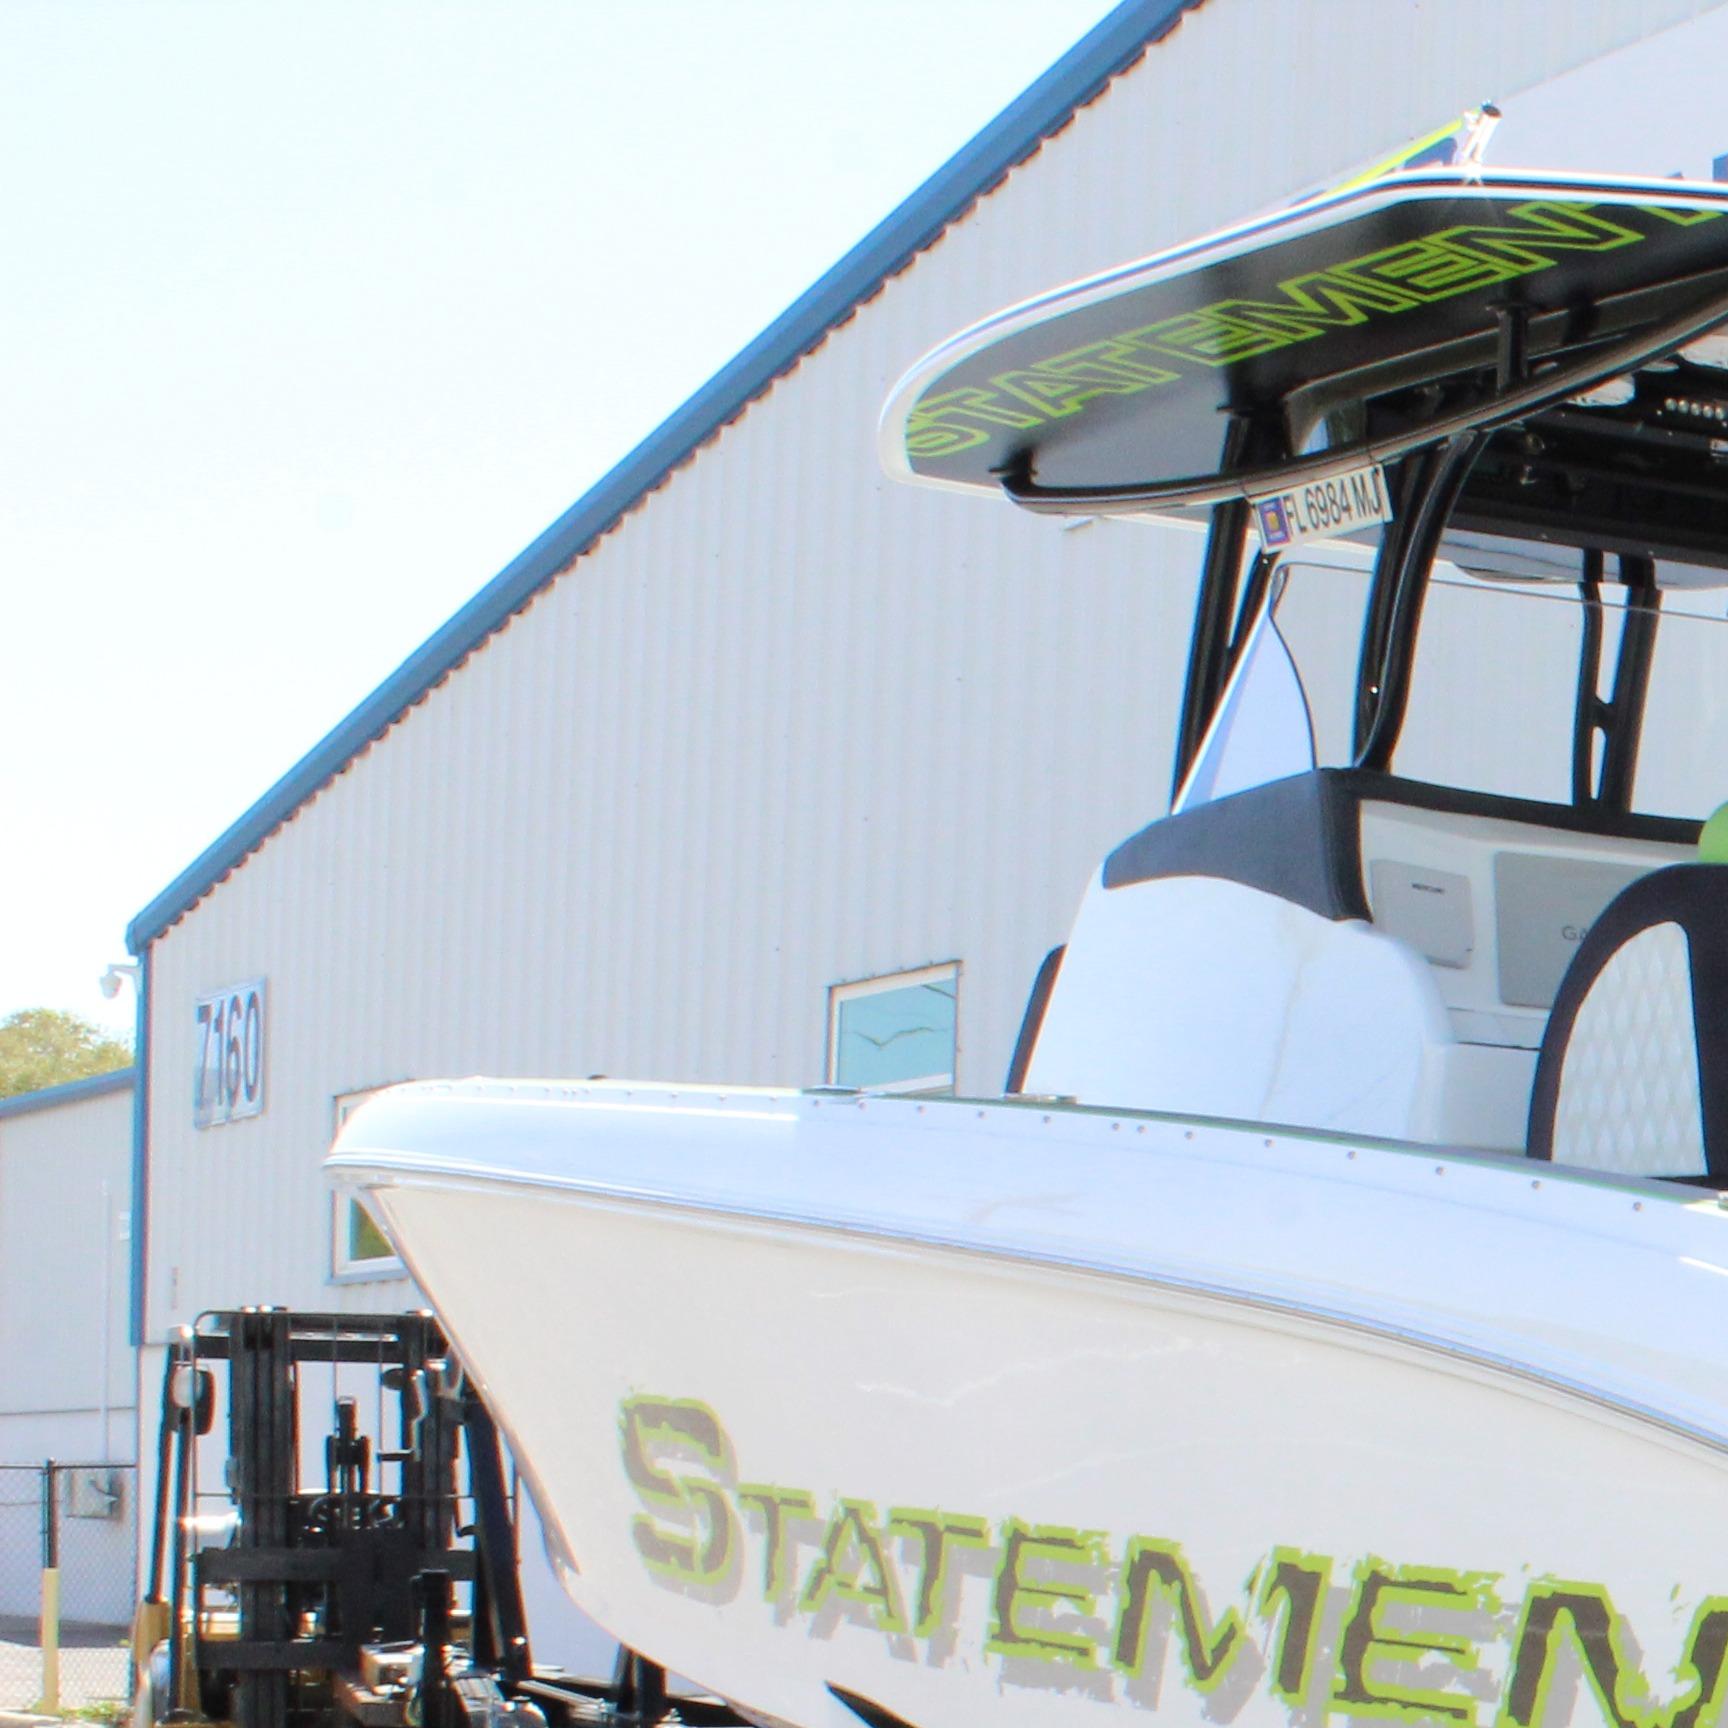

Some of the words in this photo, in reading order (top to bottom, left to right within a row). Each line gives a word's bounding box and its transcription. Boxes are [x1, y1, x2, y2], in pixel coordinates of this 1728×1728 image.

[905, 200, 1724, 458] STATEMEN
[1283, 493, 1307, 534] FL
[1304, 478, 1354, 531] 6984
[1351, 466, 1383, 518] MJ
[196, 990, 260, 1111] 7160
